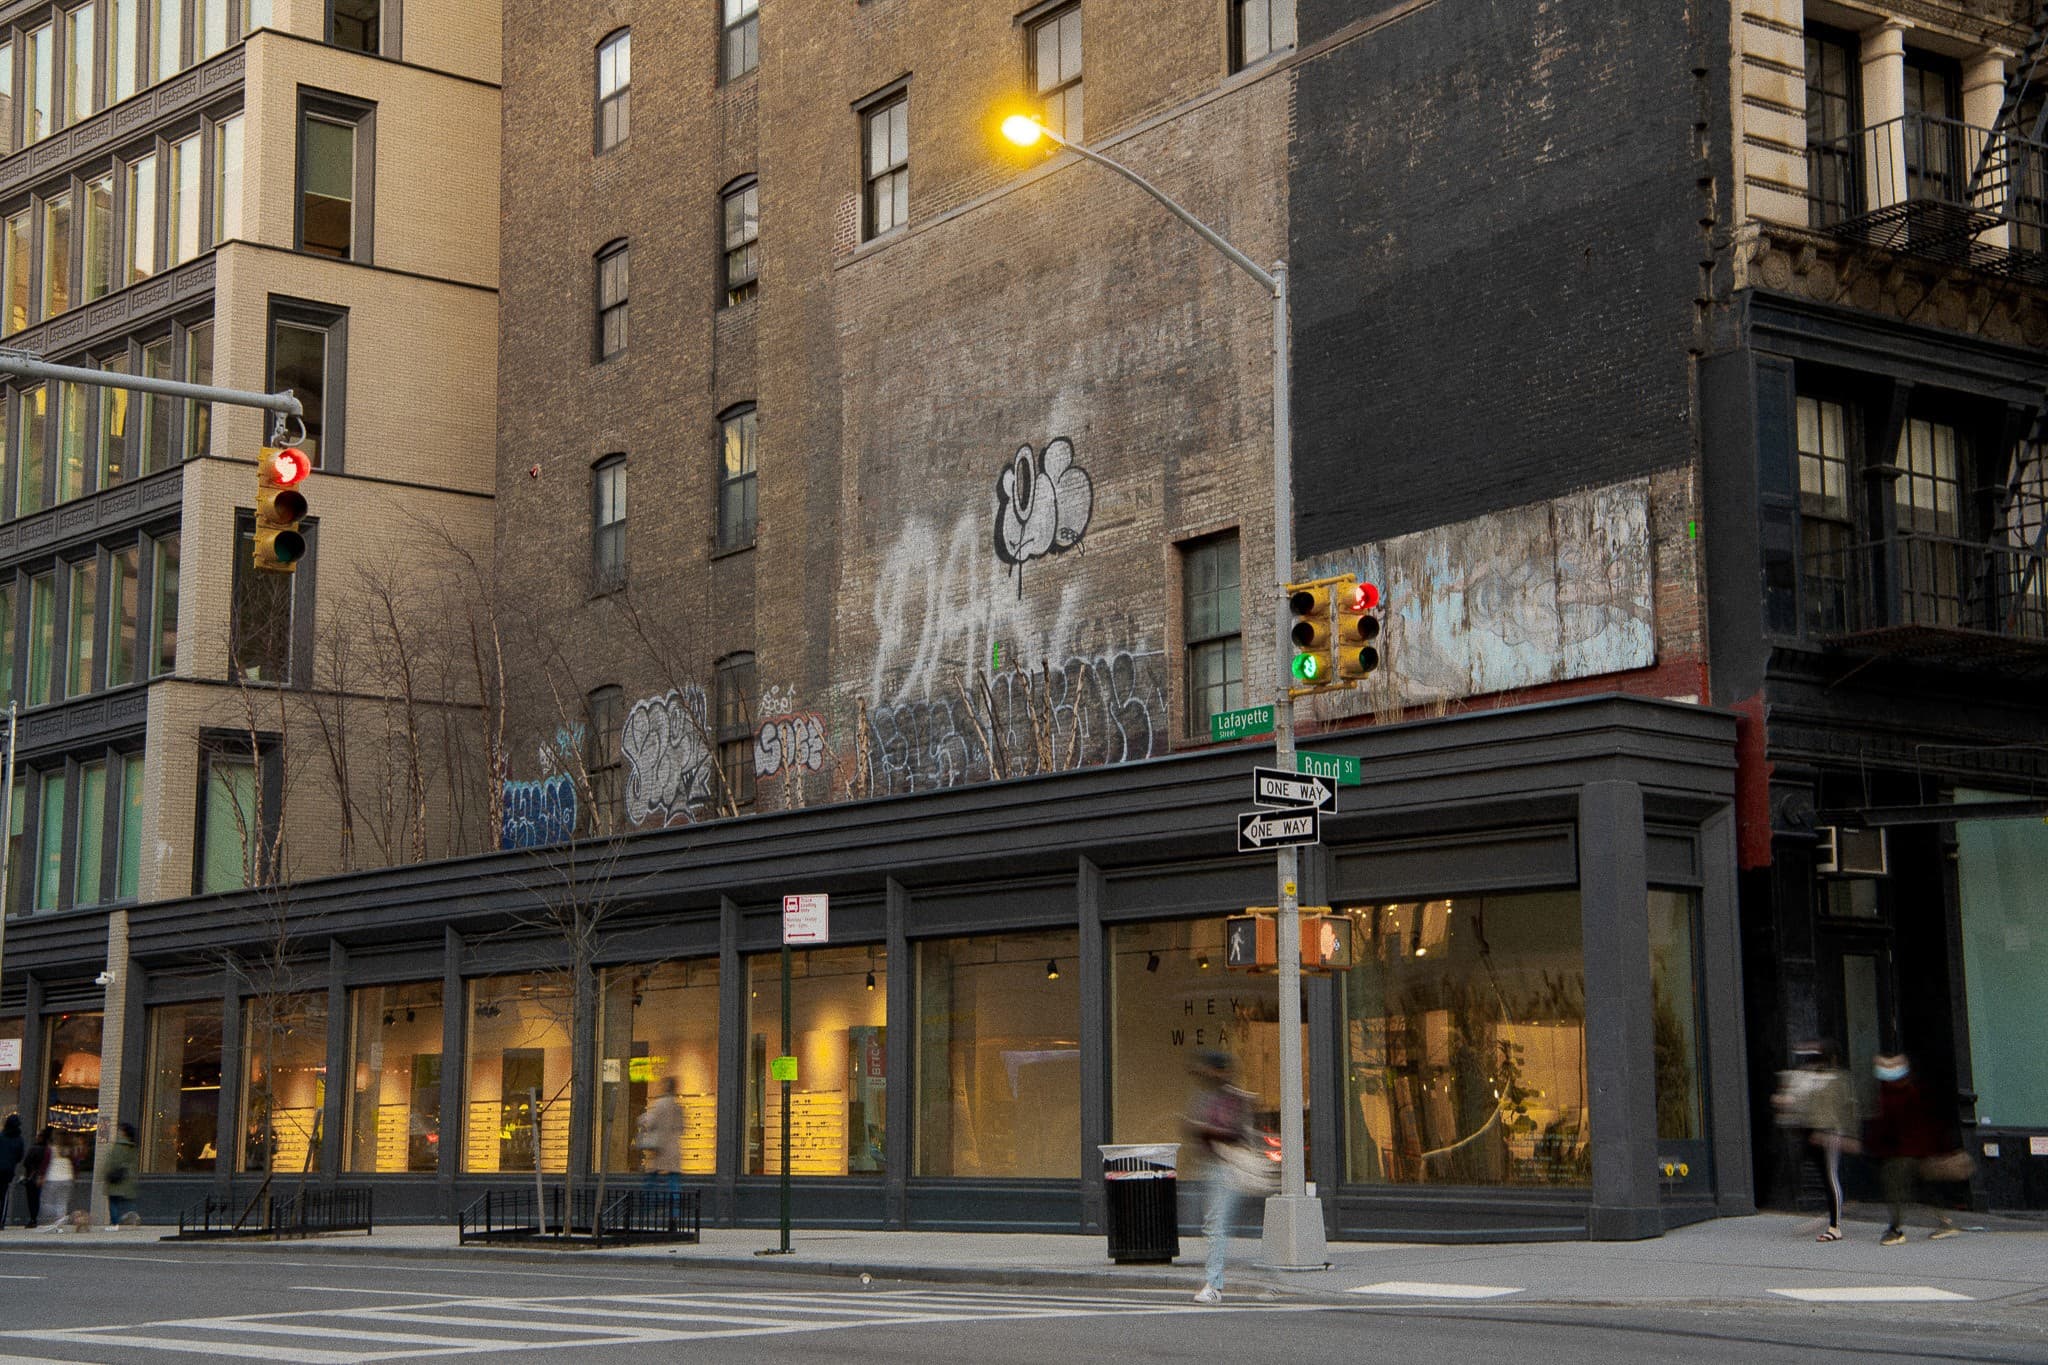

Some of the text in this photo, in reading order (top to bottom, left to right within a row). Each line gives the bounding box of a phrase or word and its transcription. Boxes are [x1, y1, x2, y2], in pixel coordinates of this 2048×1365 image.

[1218, 708, 1269, 730] Lafayette
[1305, 756, 1353, 779] Bond St
[1266, 780, 1324, 800] ONE WAY
[1250, 818, 1308, 838] ONE WAY
[1184, 998, 1238, 1016] HEY
